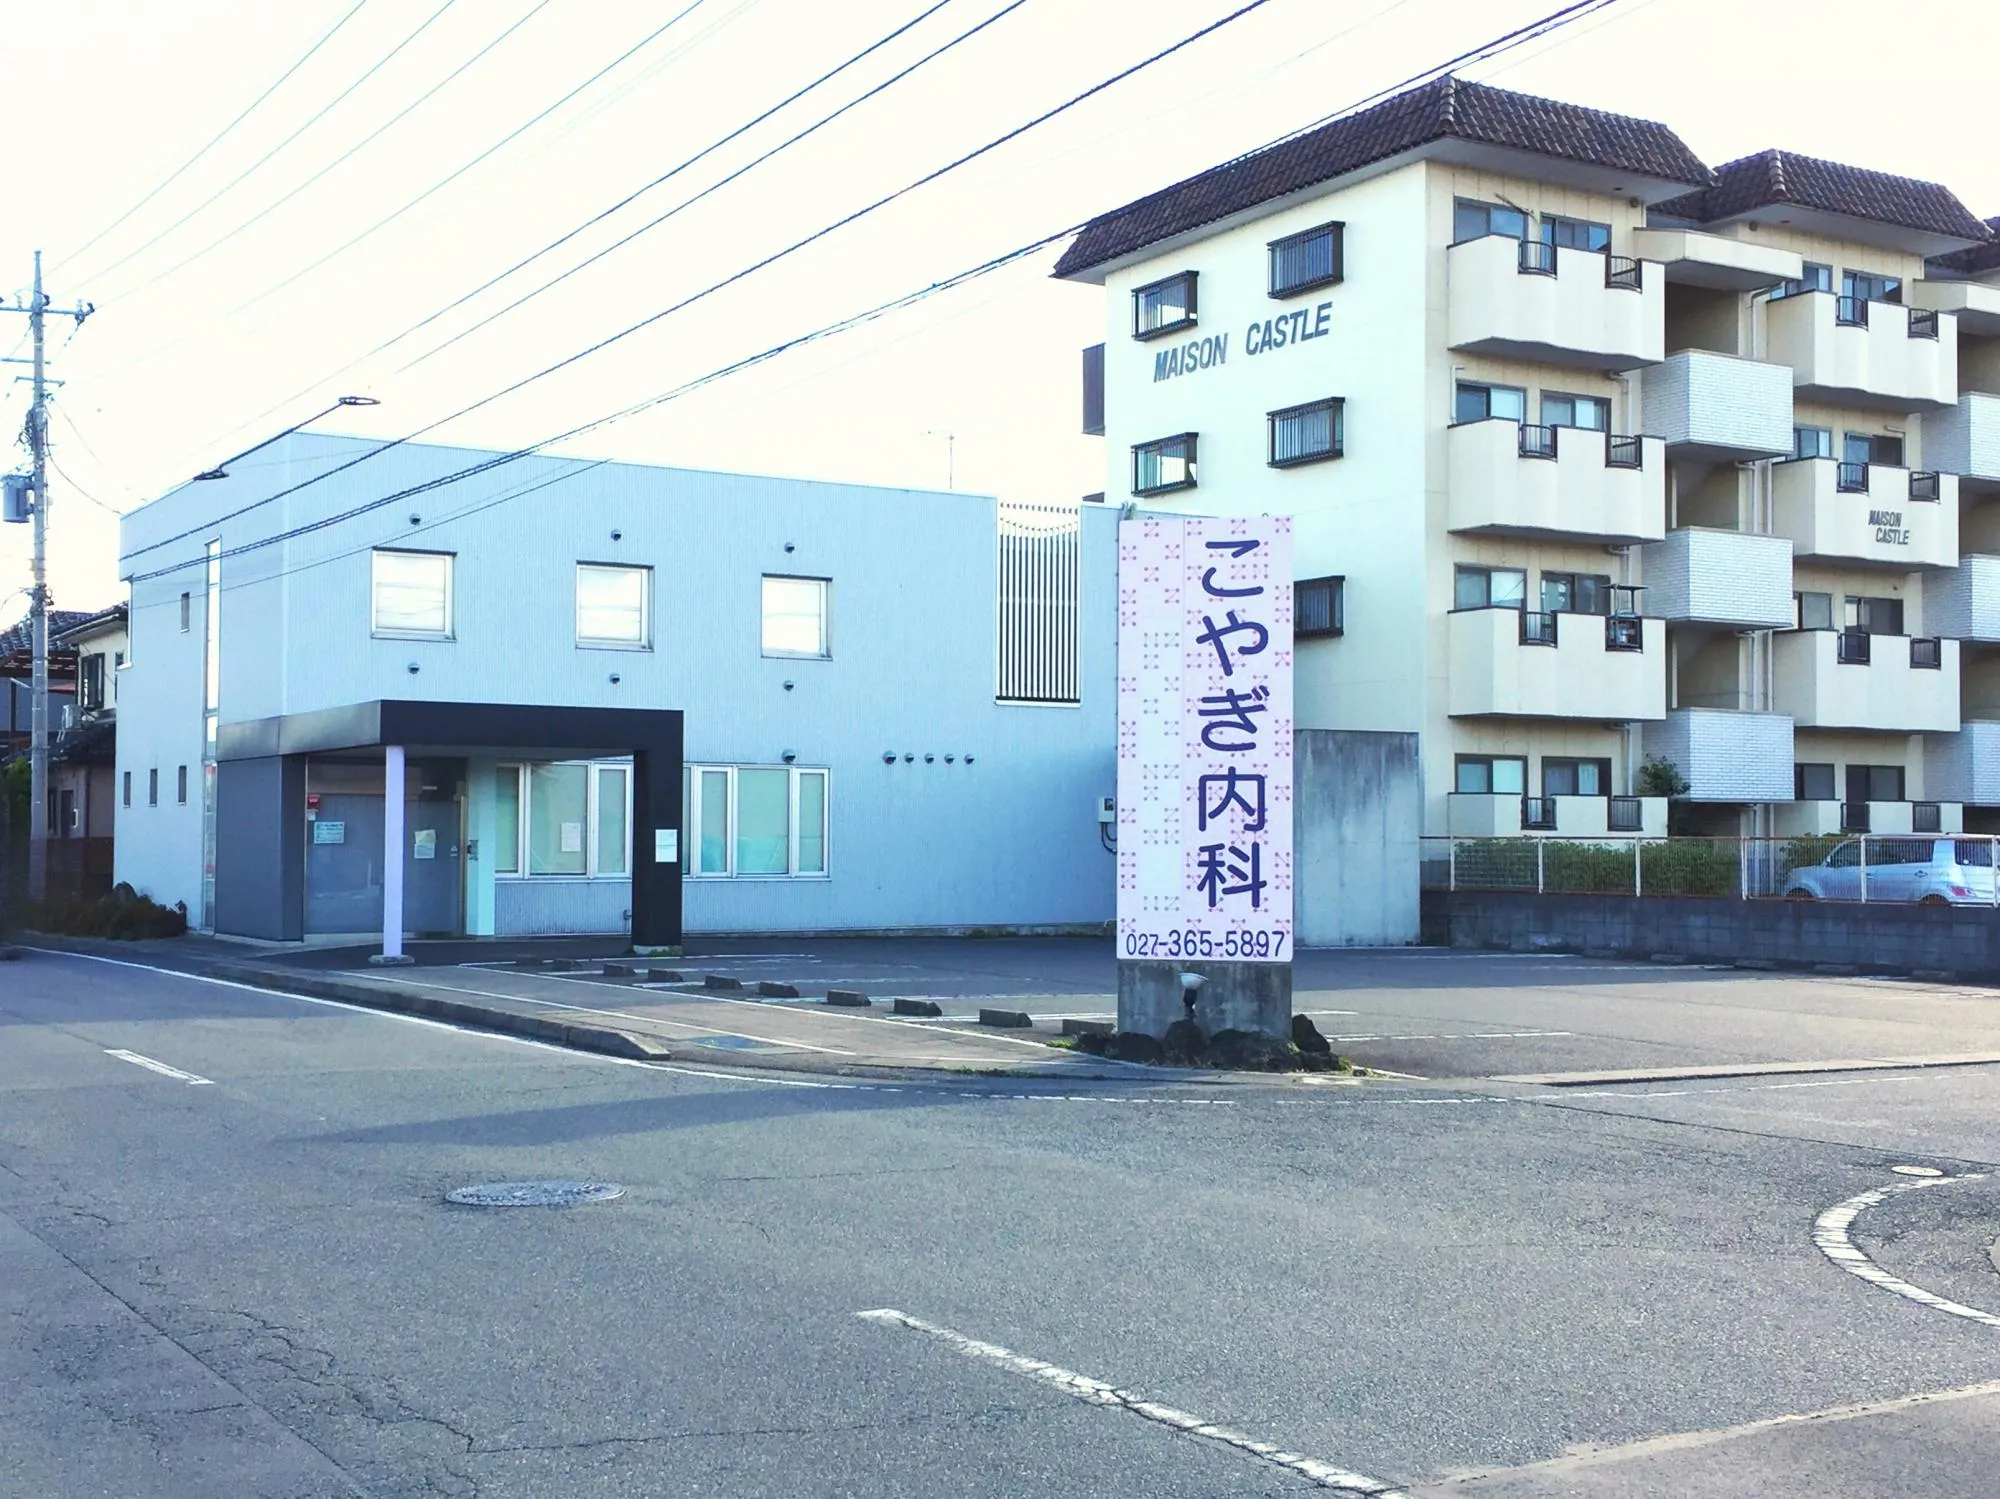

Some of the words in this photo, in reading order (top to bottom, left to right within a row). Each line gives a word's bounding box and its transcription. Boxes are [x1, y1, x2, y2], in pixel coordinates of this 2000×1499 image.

[1153, 332, 1228, 383] MAISON
[1245, 301, 1333, 356] CASTLE
[1868, 510, 1903, 527] MAISON
[1875, 527, 1910, 545] CASTLE
[1196, 539, 1269, 908] こやぎ内科
[1126, 929, 1285, 957] 027-365-5897
